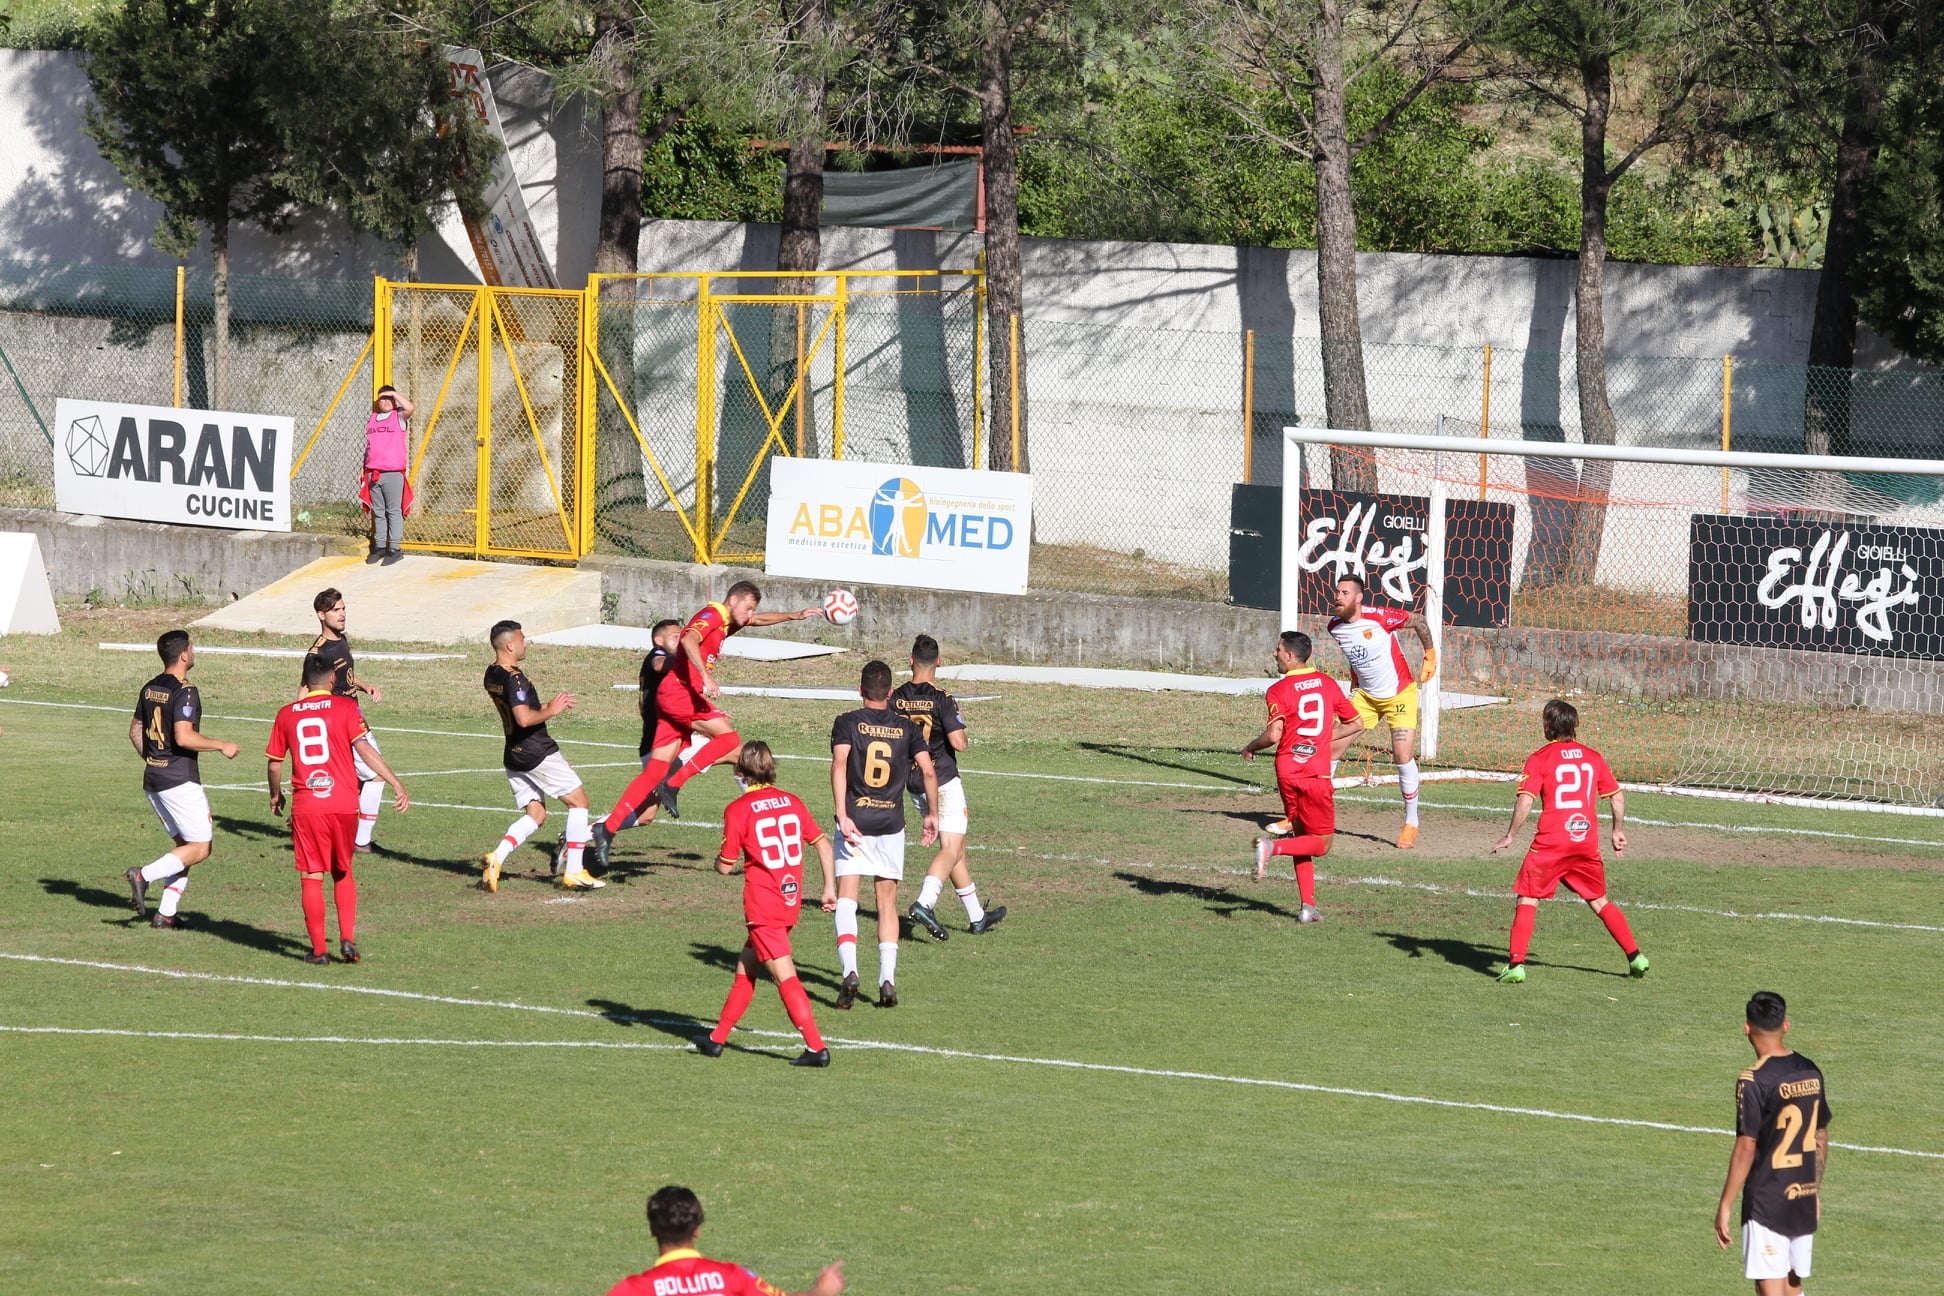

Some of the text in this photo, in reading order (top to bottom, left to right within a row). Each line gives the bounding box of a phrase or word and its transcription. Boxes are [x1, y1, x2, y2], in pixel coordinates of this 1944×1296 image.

[107, 416, 277, 493] ARAN
[186, 494, 274, 522] CUCINE
[997, 503, 1016, 511] sport
[789, 502, 1014, 551] ABA MED
[1383, 515, 1425, 532] GIOIELLI
[788, 537, 867, 550] medicina estetica
[1857, 545, 1907, 562] GIOIELLI
[1757, 530, 1920, 642] Effegi
[292, 699, 332, 713] ALIPERTA
[1296, 692, 1325, 737] 9
[1395, 704, 1406, 713] 12
[146, 706, 165, 750] 4
[296, 717, 330, 766] 8
[859, 723, 903, 737] RETTURA
[864, 740, 893, 788] 6
[750, 796, 792, 813] CRETELLA
[755, 813, 803, 870] 58
[1771, 1099, 1820, 1170] 24
[653, 1271, 726, 1296] BOLLINO
